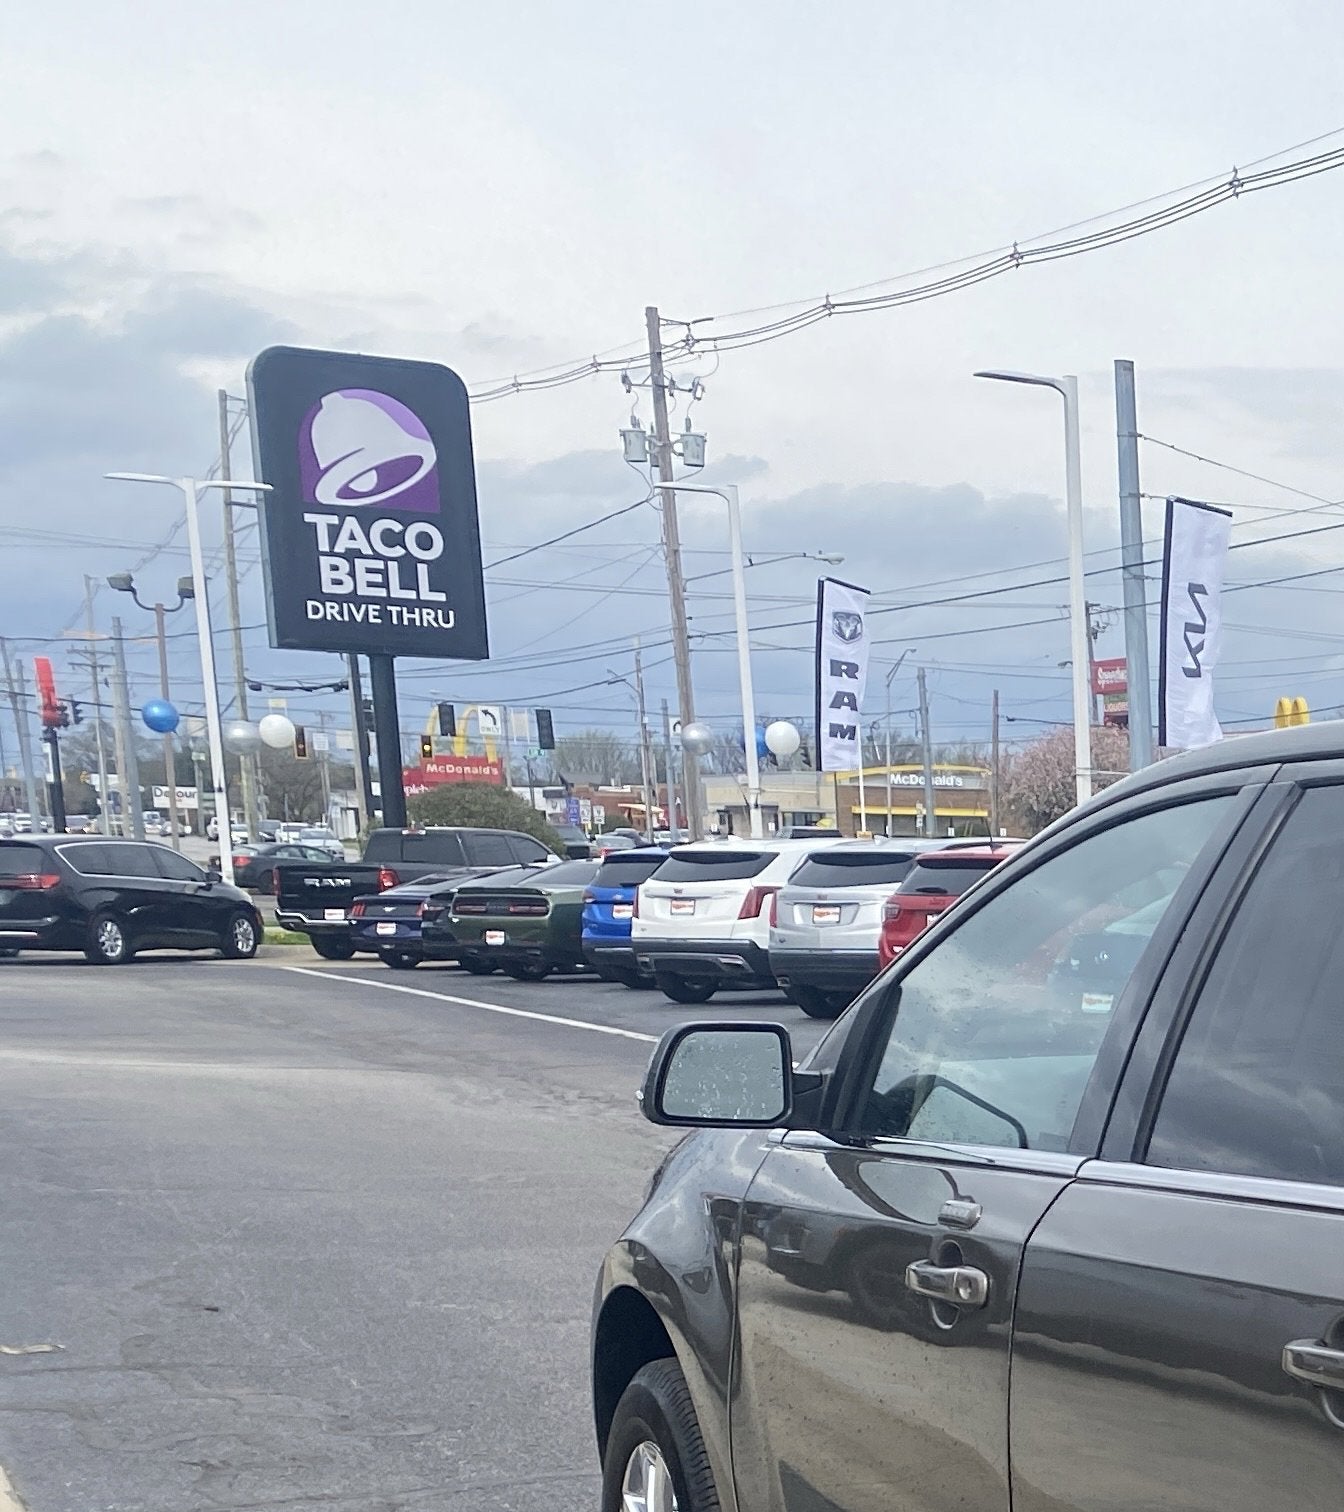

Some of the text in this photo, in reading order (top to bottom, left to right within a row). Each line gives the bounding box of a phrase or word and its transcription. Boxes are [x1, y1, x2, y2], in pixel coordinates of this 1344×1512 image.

[303, 513, 444, 561] TACO
[319, 555, 447, 602] BELL
[306, 600, 455, 628] DRIVE THRU
[829, 658, 859, 741] RAM
[426, 763, 499, 776] McDonald's
